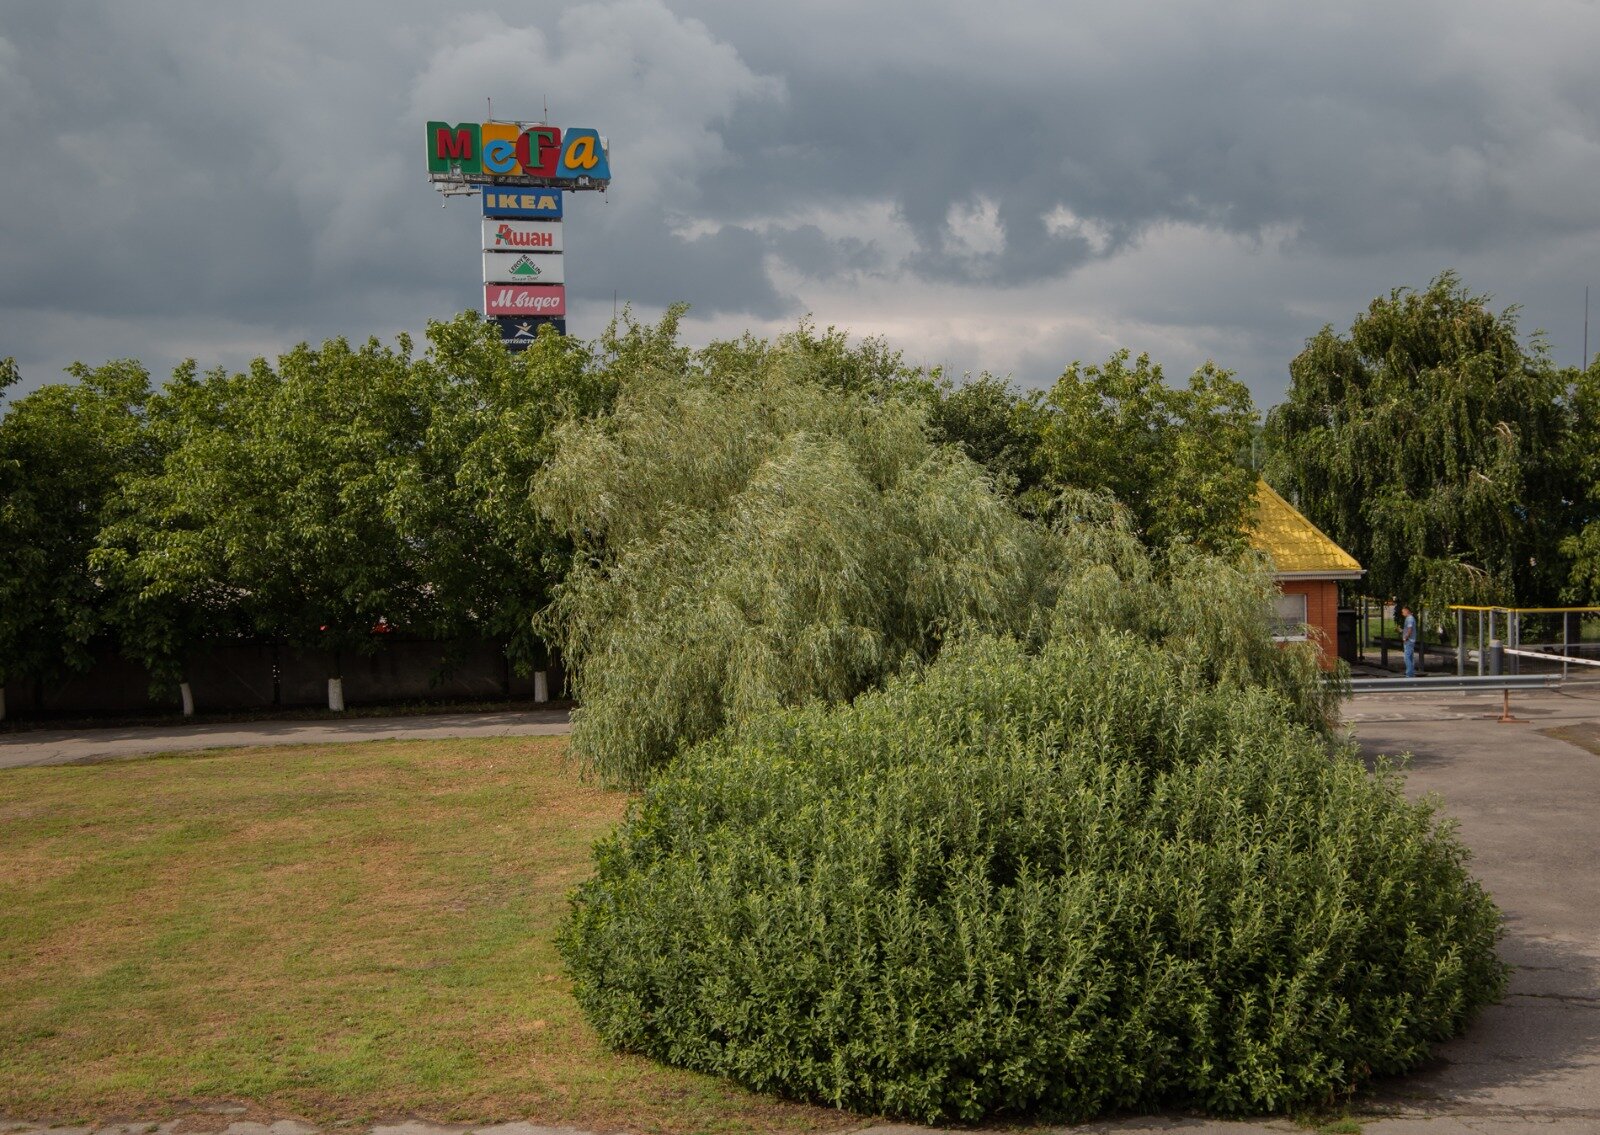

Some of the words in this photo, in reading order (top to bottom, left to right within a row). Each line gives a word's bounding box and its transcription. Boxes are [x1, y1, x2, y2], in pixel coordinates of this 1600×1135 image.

[486, 194, 557, 210] IKEA
[496, 224, 553, 247] Ашан
[508, 257, 524, 274] LEROY
[521, 254, 542, 275] MERLIN
[491, 289, 560, 312] М.видео
